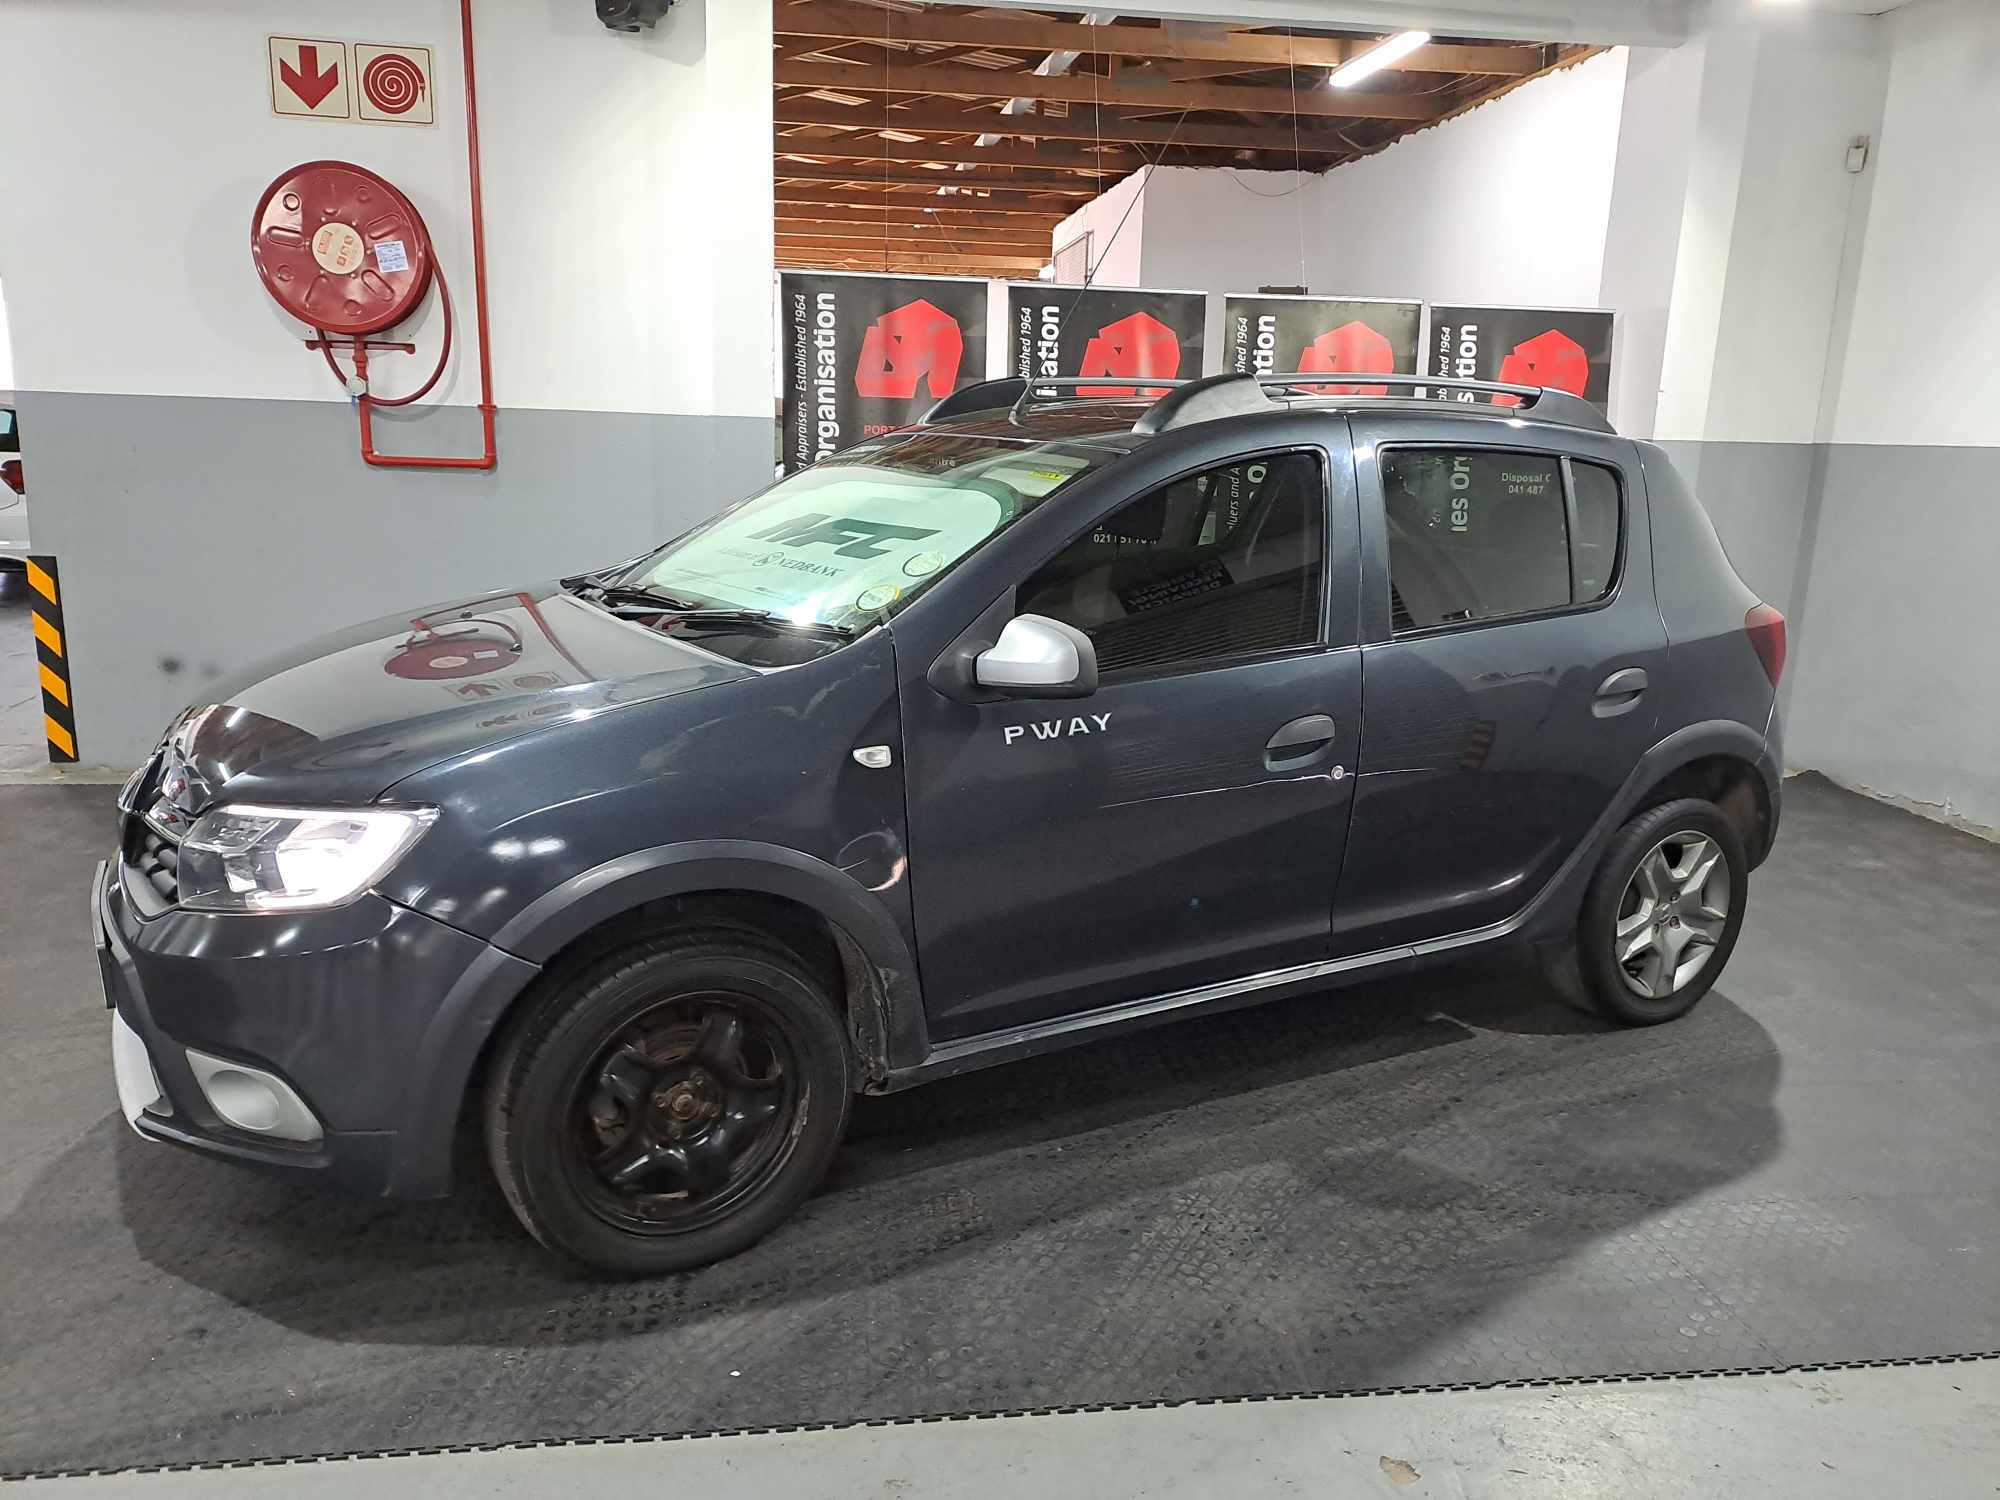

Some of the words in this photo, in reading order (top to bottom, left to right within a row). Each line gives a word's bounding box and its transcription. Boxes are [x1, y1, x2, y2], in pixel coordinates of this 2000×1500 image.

[795, 294, 806, 322] 1964
[1020, 307, 1031, 334] 1964
[1237, 317, 1248, 343] 1964
[1440, 326, 1451, 352] 1964
[794, 325, 807, 391] Established
[795, 401, 809, 460] Appraisers
[1230, 476, 1240, 498] and
[1093, 533, 1111, 544] 021
[778, 557, 847, 577] NEDBANK
[1003, 712, 1112, 745] PWAY
